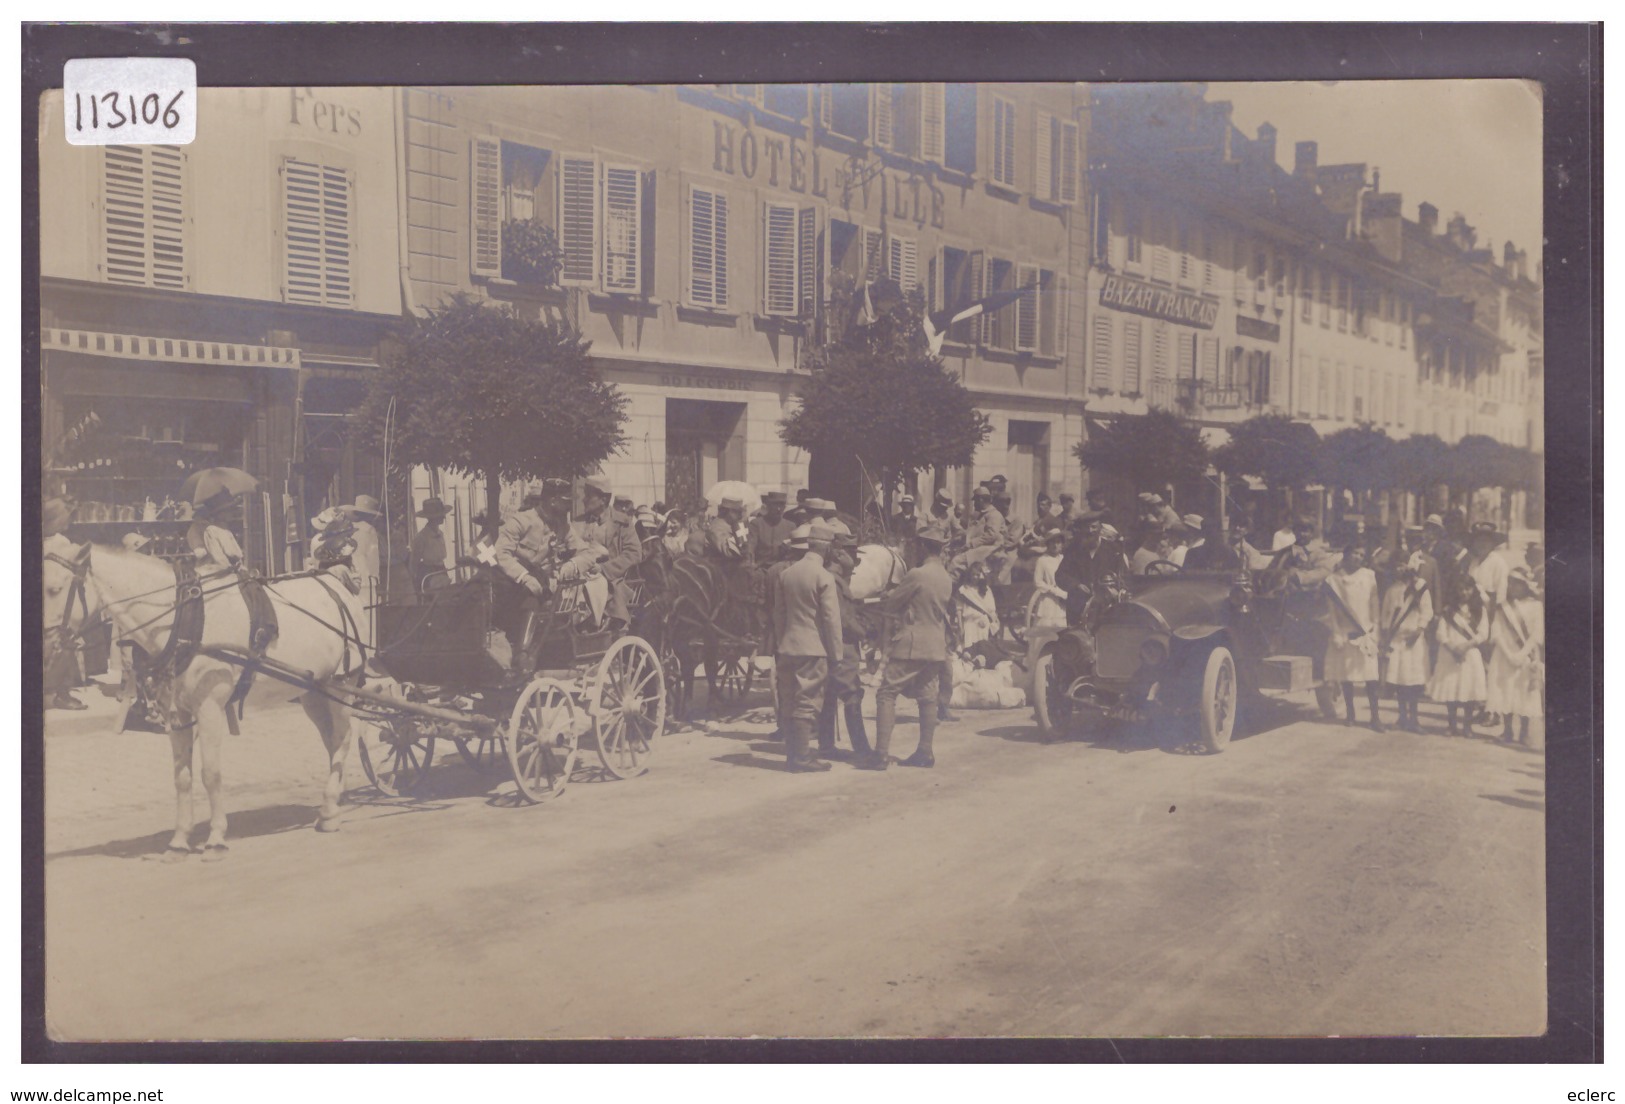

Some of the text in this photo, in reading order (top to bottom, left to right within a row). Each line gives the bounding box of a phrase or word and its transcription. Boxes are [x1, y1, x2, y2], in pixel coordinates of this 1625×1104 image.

[76, 90, 184, 131] 113106
[289, 88, 362, 136] Fers
[855, 158, 945, 230] VILLE
[1103, 276, 1153, 311] BAZAR
[1204, 391, 1240, 407] BAZAR
